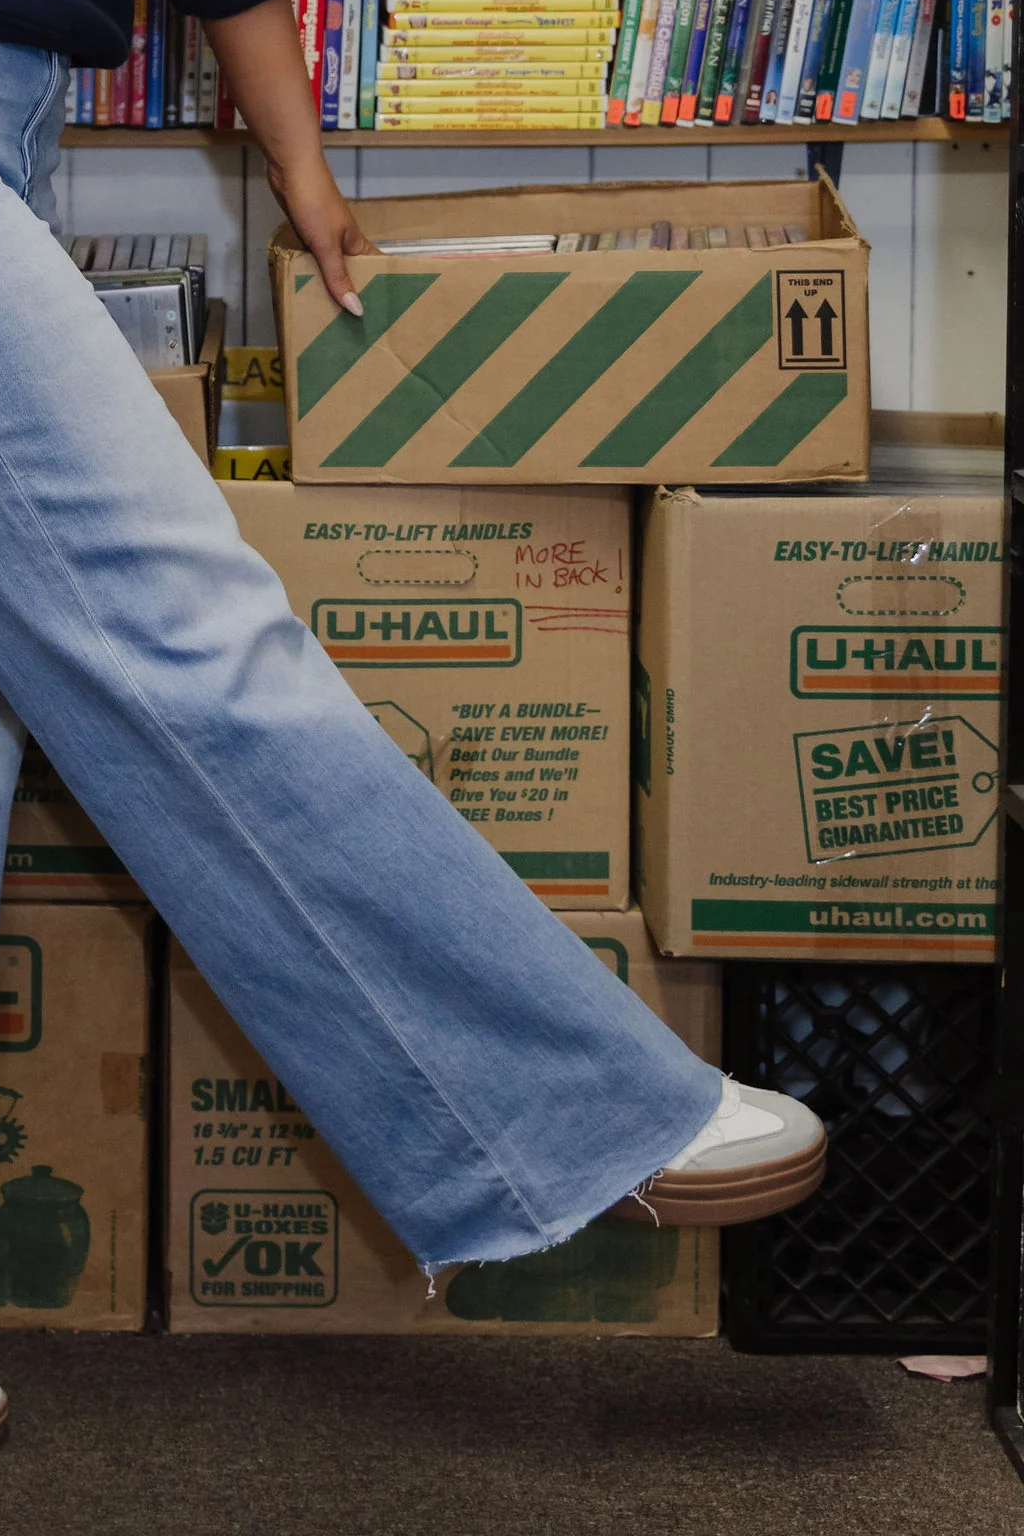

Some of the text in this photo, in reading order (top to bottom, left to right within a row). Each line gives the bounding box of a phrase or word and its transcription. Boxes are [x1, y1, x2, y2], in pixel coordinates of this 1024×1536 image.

[708, 31, 725, 67] PAN
[787, 278, 833, 287] THIS END
[803, 289, 819, 297] UP
[303, 522, 533, 541] EASY-TO-LIFT HANDLES
[515, 541, 587, 565] MORE
[775, 541, 1003, 562] EASY-TO-LIFT HANDL
[516, 572, 541, 589] IN
[499, 705, 511, 718] A
[450, 726, 608, 742] SAVE EVEN MORE!
[450, 748, 580, 762] Beat Our Bundle
[811, 730, 957, 781] SAVE!
[450, 768, 578, 782] Prices and We'll
[450, 788, 484, 802] Give
[488, 788, 517, 802] You
[552, 788, 569, 801] in
[815, 785, 960, 822] BEST PRICE
[495, 808, 542, 822] Boxes
[818, 813, 964, 850] GUARANTEED
[709, 872, 999, 891] Industry-leading sidewall strength at the
[809, 906, 987, 929] uhaul.com
[191, 1078, 302, 1113] SMAL
[194, 1146, 297, 1165] 1.5 CU FT
[234, 1220, 329, 1235] BOXES
[244, 1240, 325, 1276] OK
[200, 1282, 325, 1298] FOR SHIPPING
